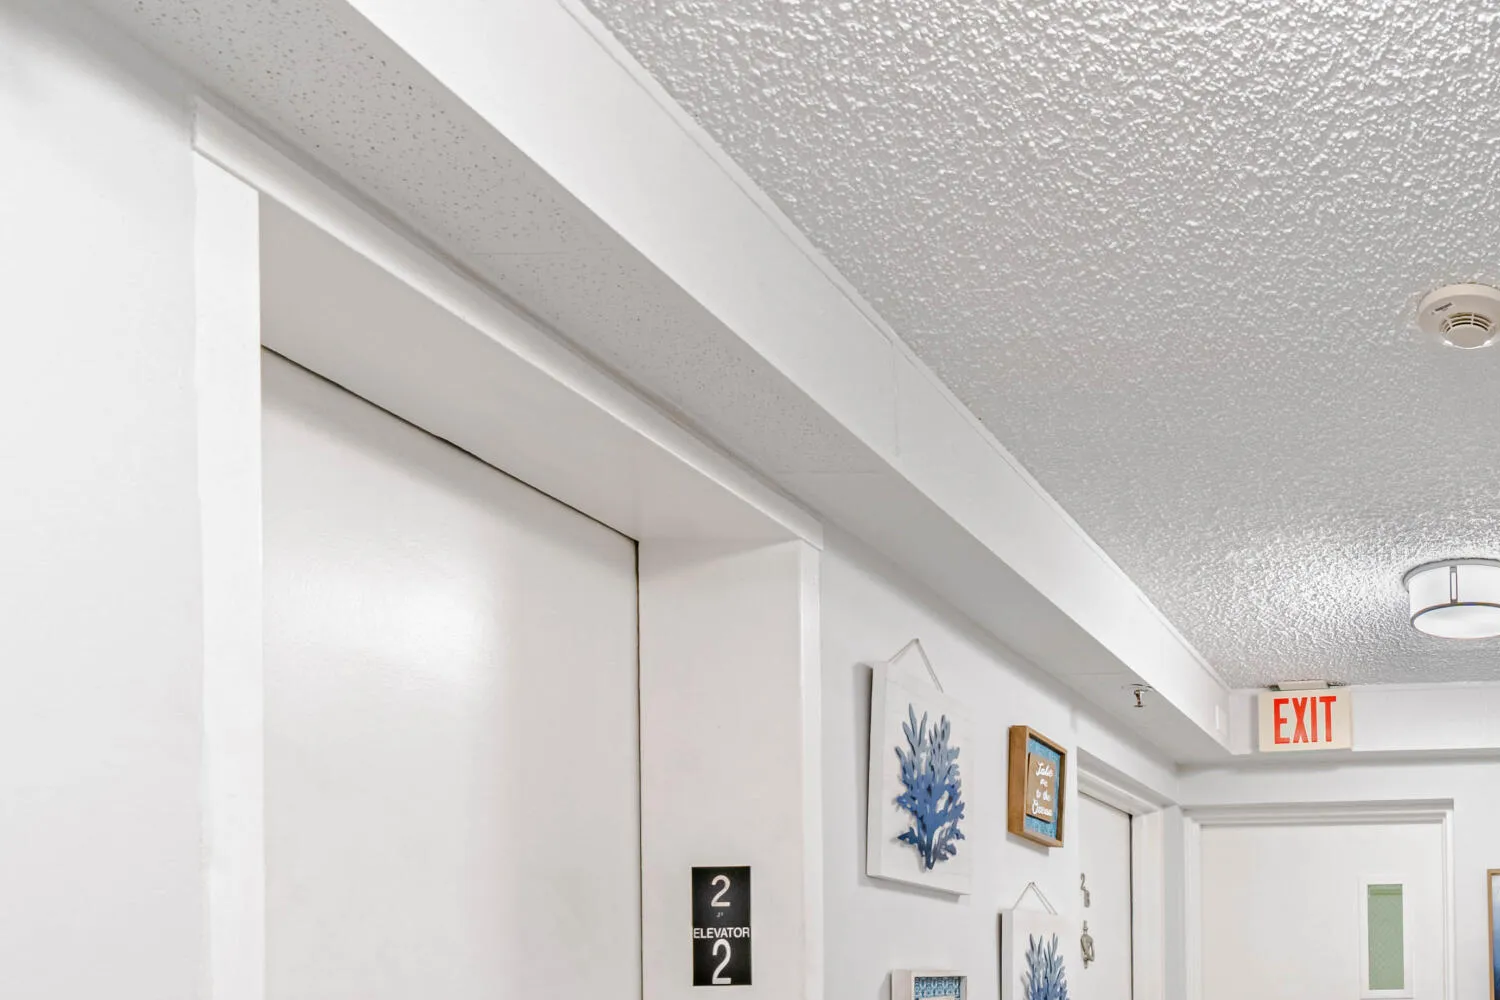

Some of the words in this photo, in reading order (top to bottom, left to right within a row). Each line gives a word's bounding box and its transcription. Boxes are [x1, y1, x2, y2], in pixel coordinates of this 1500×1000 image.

[1273, 696, 1337, 744] EXIT
[711, 874, 731, 907] 2
[693, 927, 750, 939] ELEVATOR
[712, 938, 732, 985] 2
